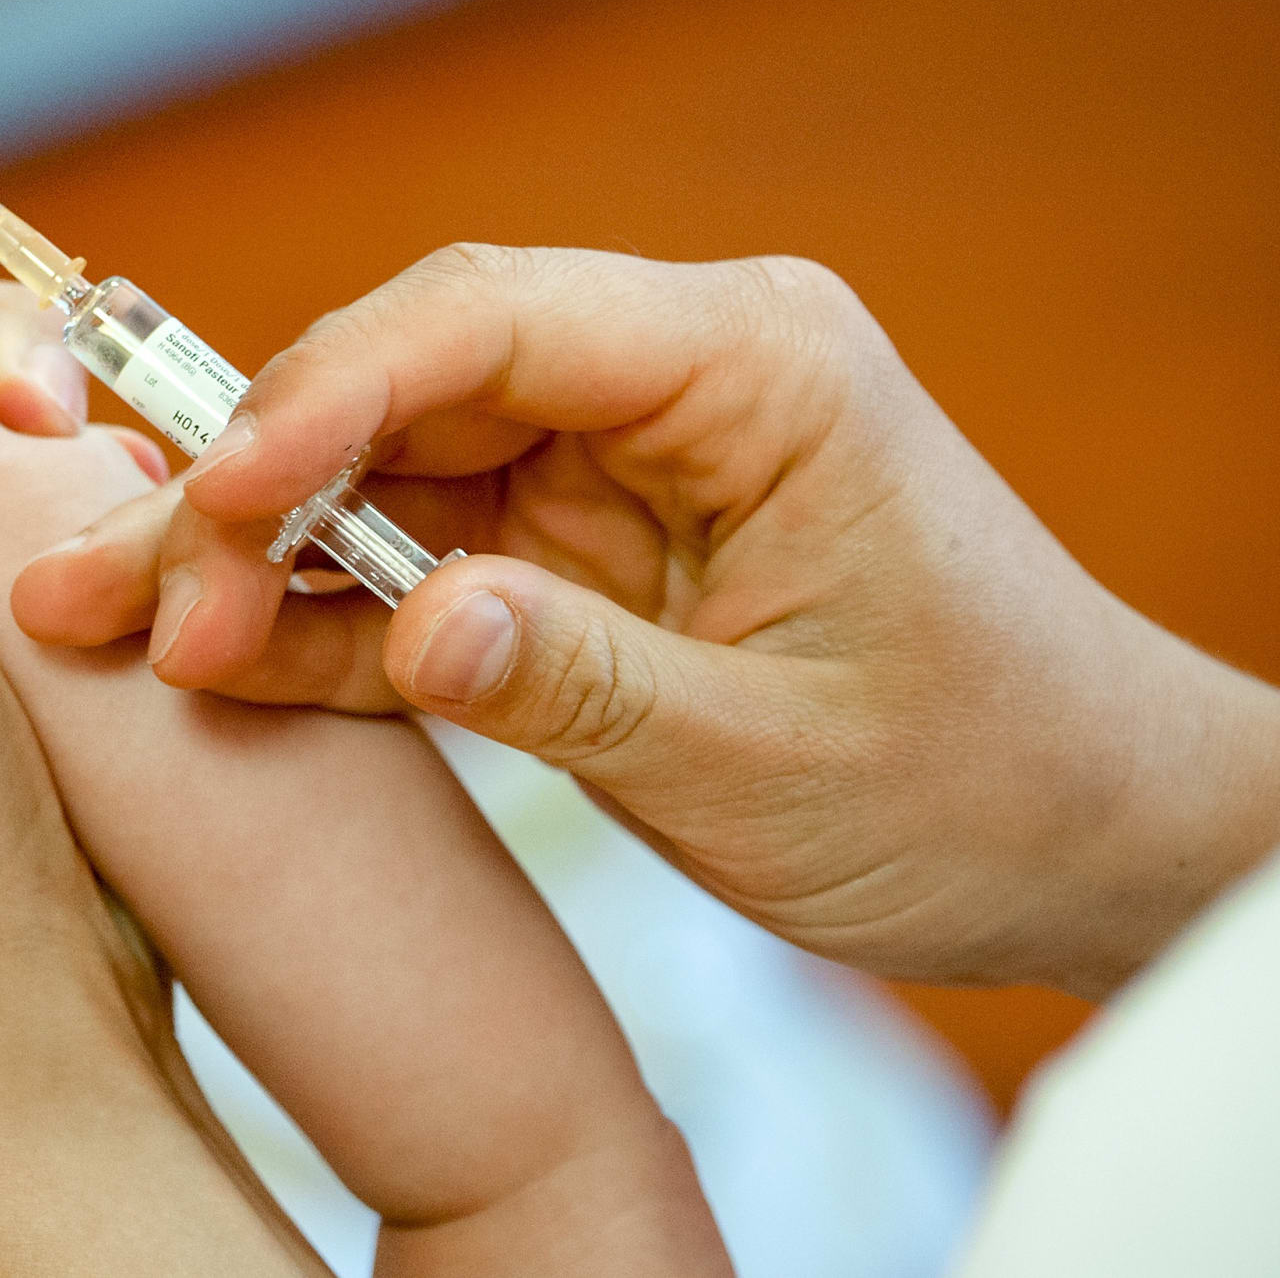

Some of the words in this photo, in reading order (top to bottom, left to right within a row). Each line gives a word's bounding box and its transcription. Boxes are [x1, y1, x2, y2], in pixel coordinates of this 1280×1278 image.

[144, 373, 158, 388] Lot
[166, 333, 201, 362] Sanofi
[199, 360, 239, 395] Pasteur
[172, 410, 215, 445] H014
